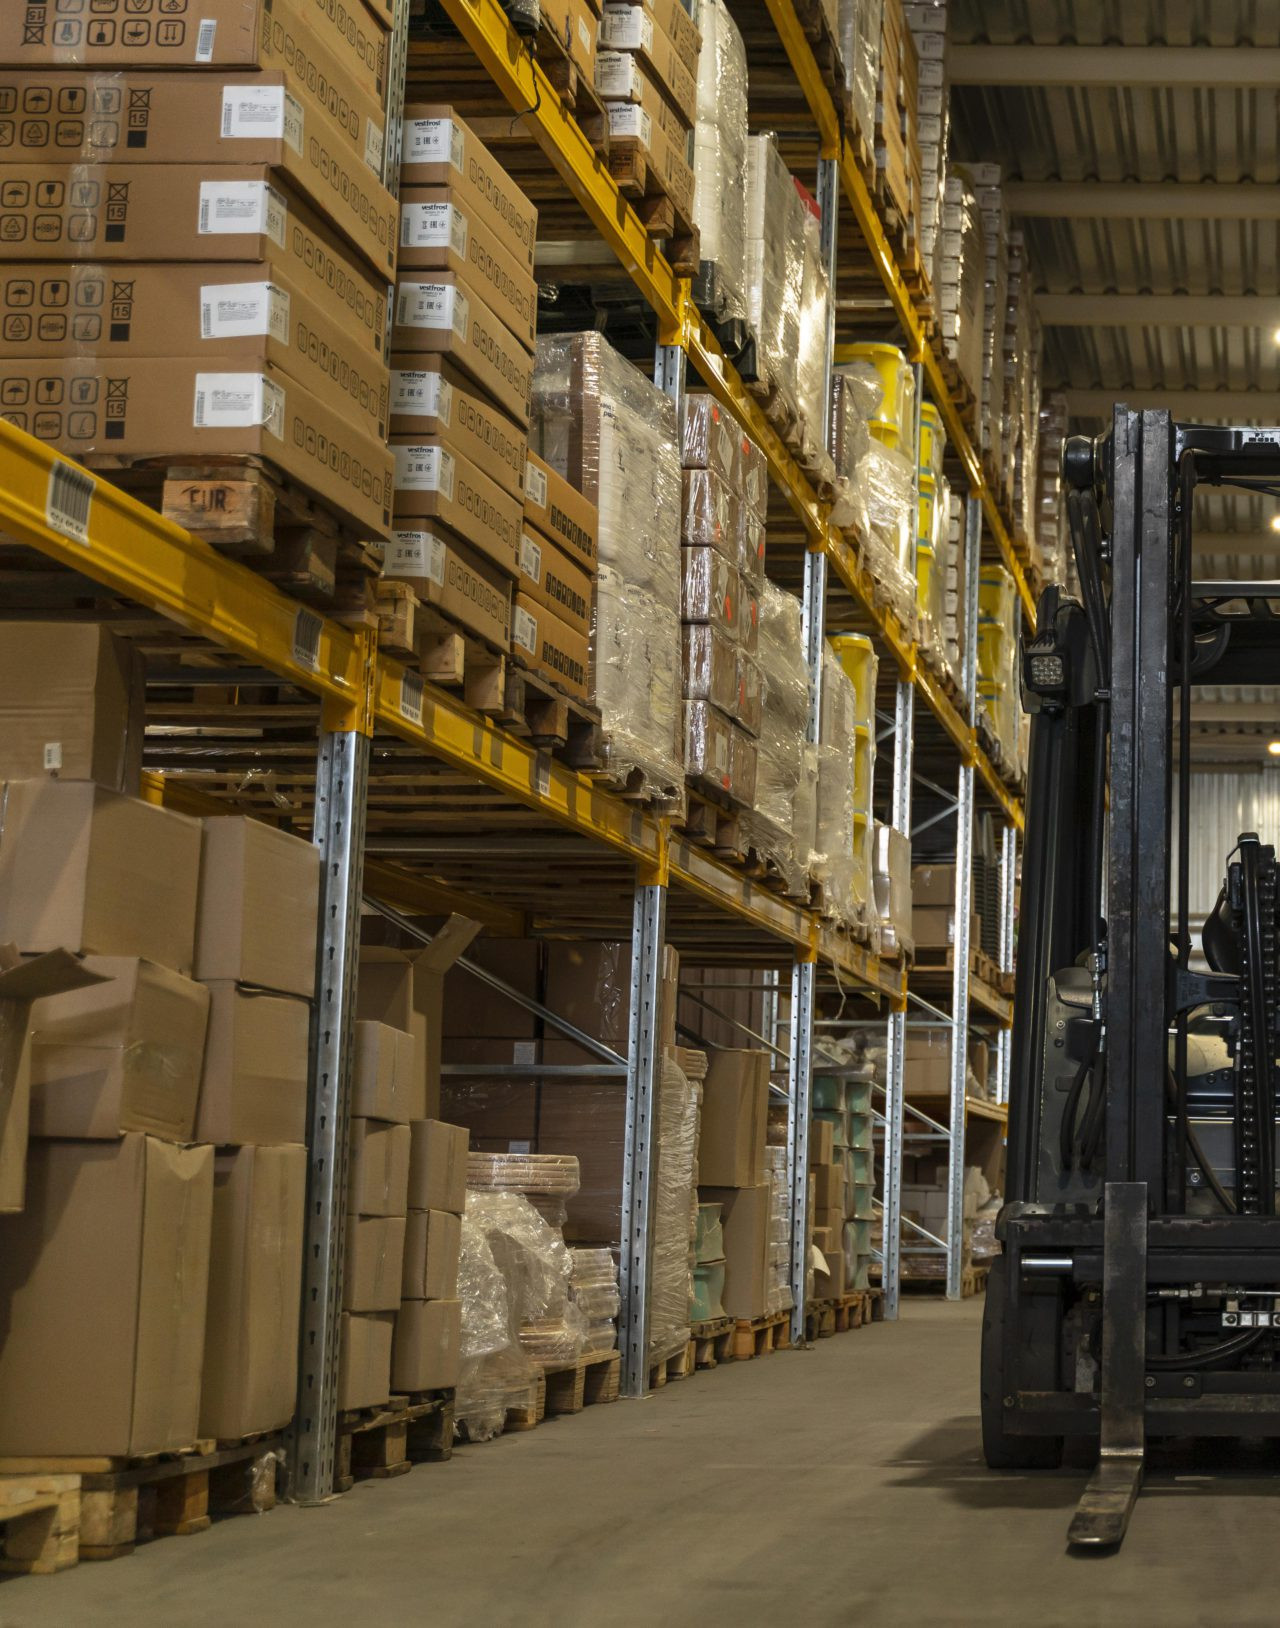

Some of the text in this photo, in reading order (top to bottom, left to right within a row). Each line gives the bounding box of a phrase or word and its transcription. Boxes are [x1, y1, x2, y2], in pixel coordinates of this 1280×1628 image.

[29, 9, 43, 21] 15
[131, 113, 146, 123] 15
[110, 207, 124, 218] 15
[419, 284, 446, 292] vestfrost
[114, 306, 129, 317] 15
[109, 404, 124, 414] 15
[407, 446, 434, 454] vestfrost
